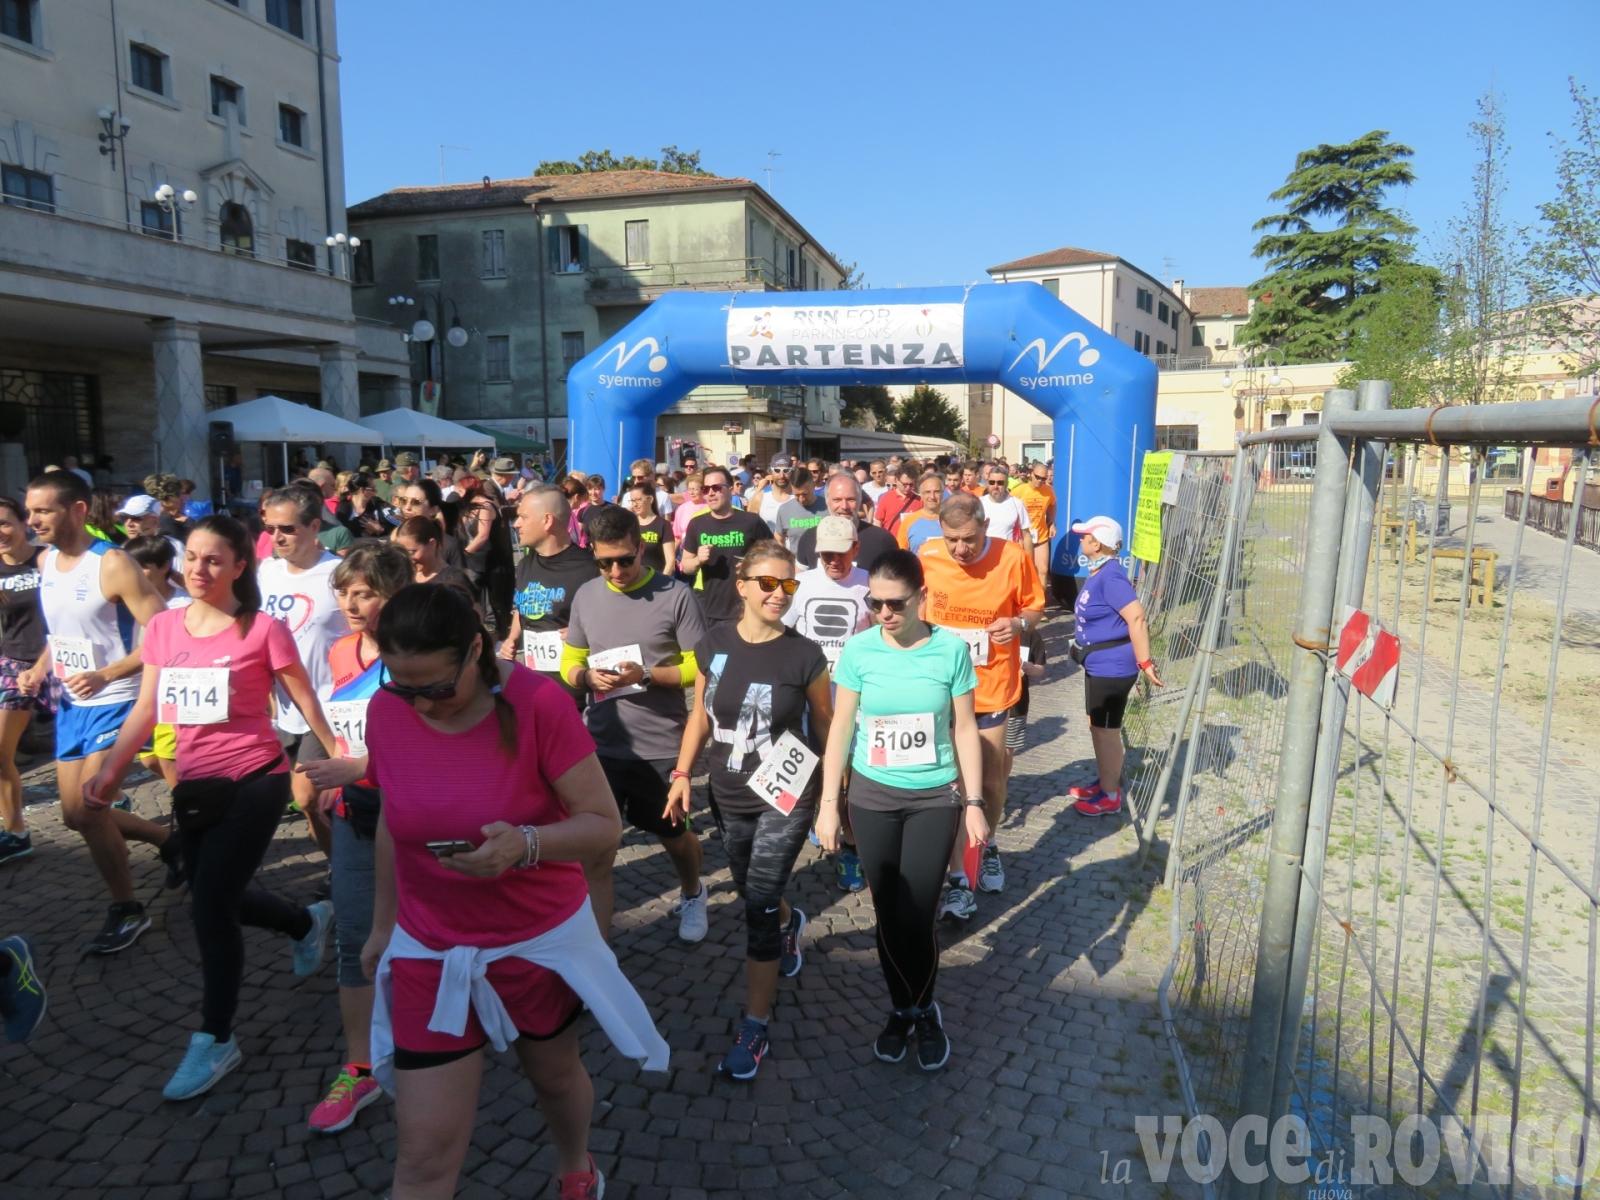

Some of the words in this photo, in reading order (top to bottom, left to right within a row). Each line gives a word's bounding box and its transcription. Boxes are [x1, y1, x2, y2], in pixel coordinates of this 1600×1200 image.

[793, 309, 839, 325] RUN
[847, 308, 891, 325] FOR
[731, 343, 962, 366] PARTENZA
[598, 374, 662, 389] syemme
[1020, 372, 1094, 390] syemme
[700, 530, 745, 546] CrossFit
[265, 594, 296, 611] RO
[56, 651, 89, 669] 4200
[527, 644, 558, 660] 5115
[165, 686, 219, 707] 5114
[333, 719, 363, 741] 511
[874, 730, 927, 751] 5109
[764, 746, 806, 801] 5108
